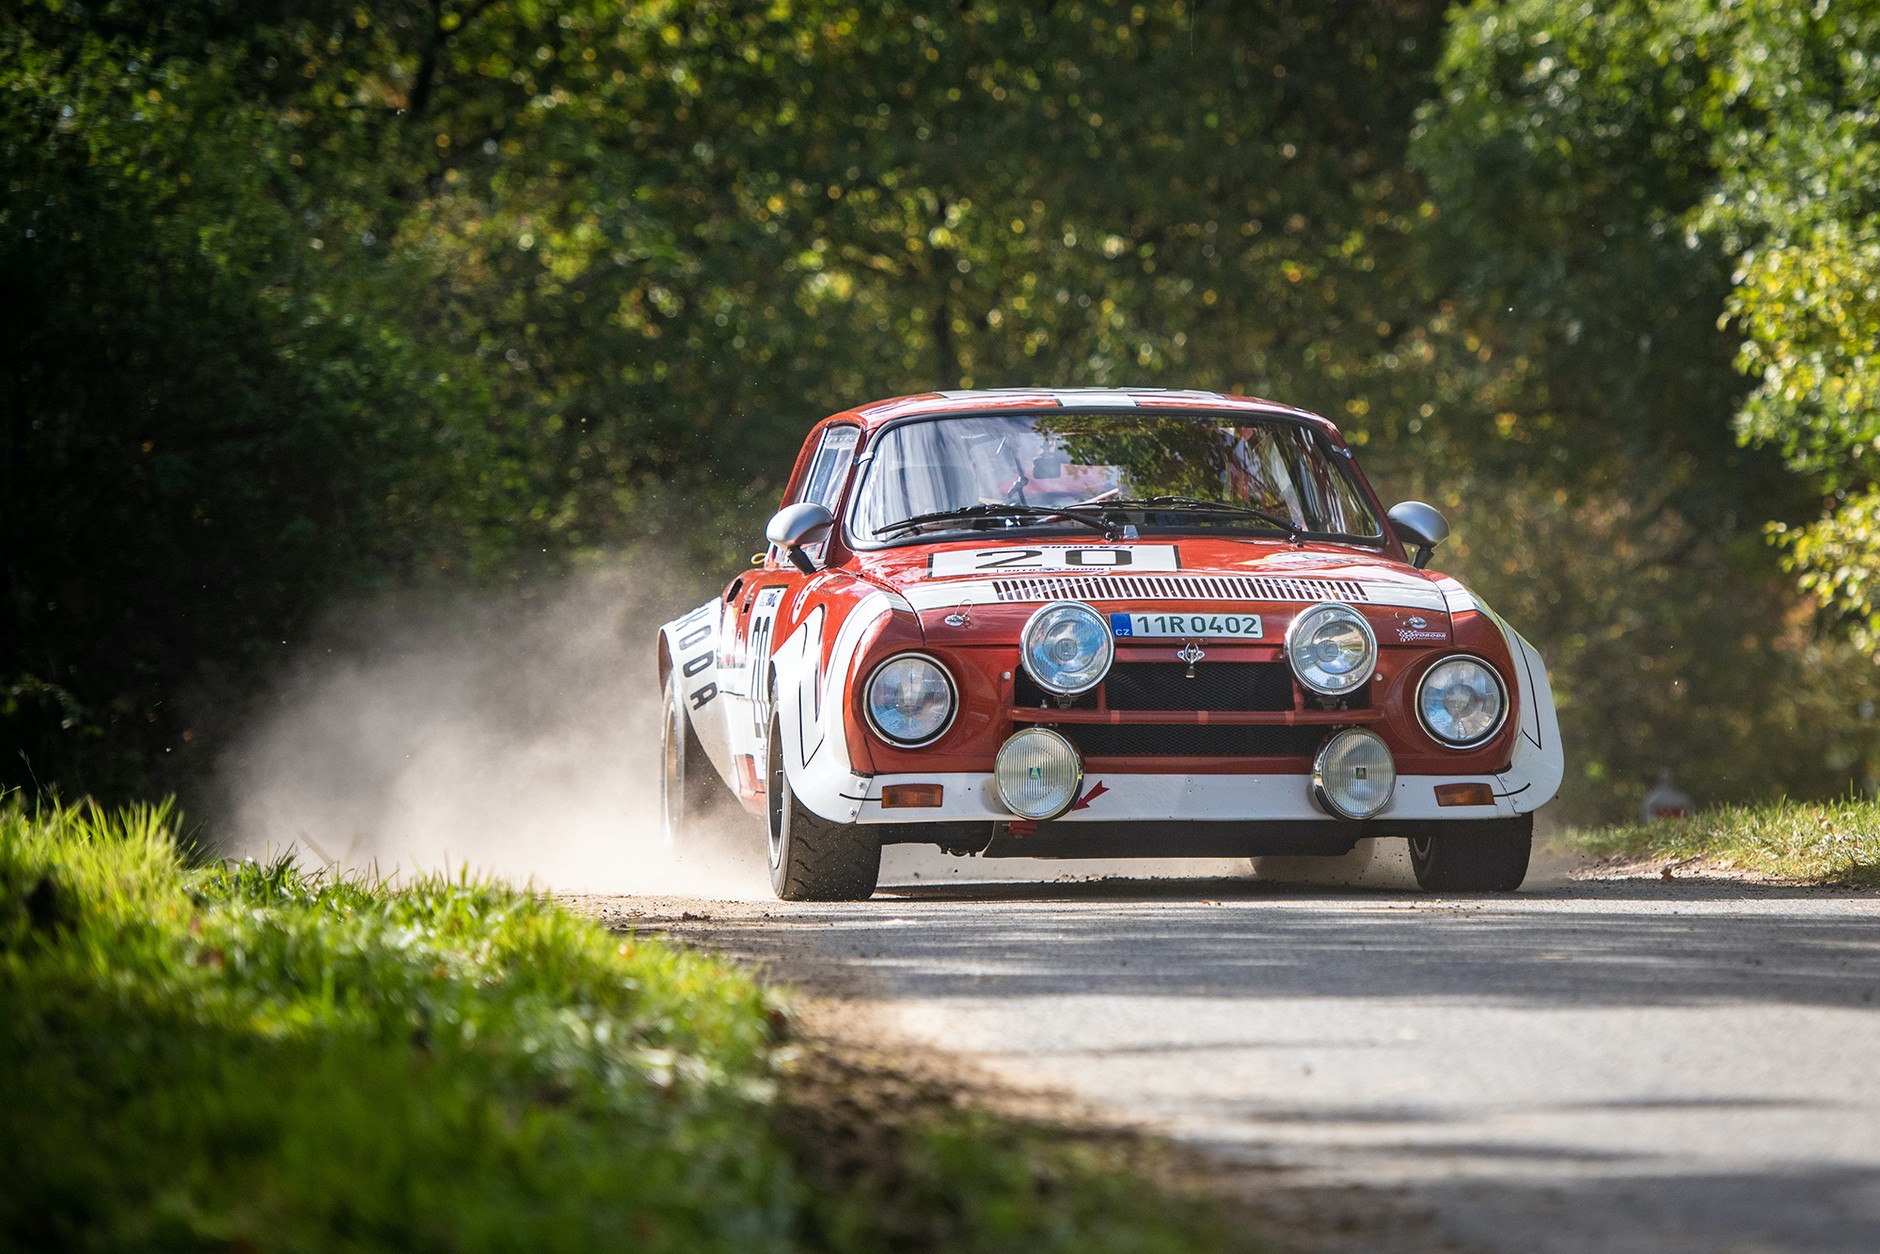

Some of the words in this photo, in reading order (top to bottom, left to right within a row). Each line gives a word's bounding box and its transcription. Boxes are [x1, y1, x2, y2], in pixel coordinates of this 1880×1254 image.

[975, 550, 1132, 569] 20
[1115, 628, 1131, 636] CZ
[1137, 616, 1186, 633] 11R
[1190, 616, 1258, 634] 0402
[675, 606, 718, 711] KODA
